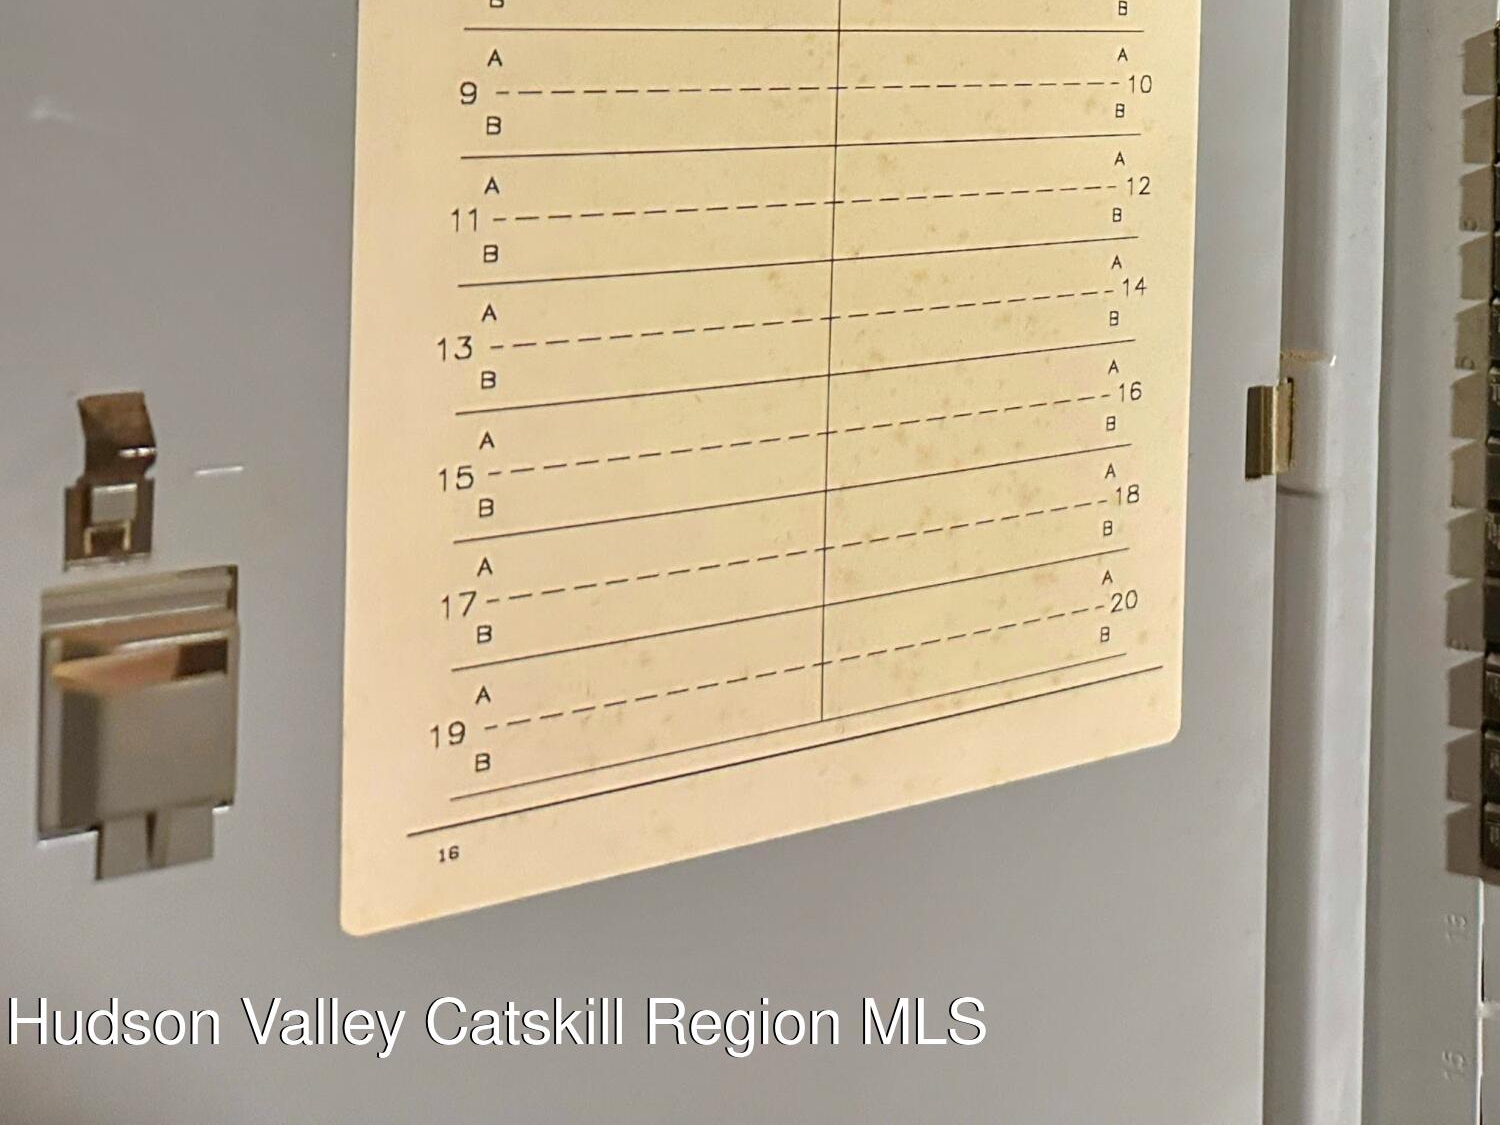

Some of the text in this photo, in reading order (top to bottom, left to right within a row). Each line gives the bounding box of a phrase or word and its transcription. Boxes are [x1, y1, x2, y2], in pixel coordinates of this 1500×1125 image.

[460, 82, 477, 105] 9
[1129, 75, 1152, 93] 10
[1128, 176, 1150, 195] 12
[452, 208, 477, 232] 11
[1123, 277, 1146, 296] 14
[438, 336, 472, 361] 13
[1119, 381, 1141, 402] 16
[440, 465, 474, 491] 15
[1116, 484, 1139, 505] 18
[442, 591, 476, 619] 17
[1111, 590, 1137, 613] 20
[431, 721, 465, 748] 19
[440, 846, 459, 862] 16
